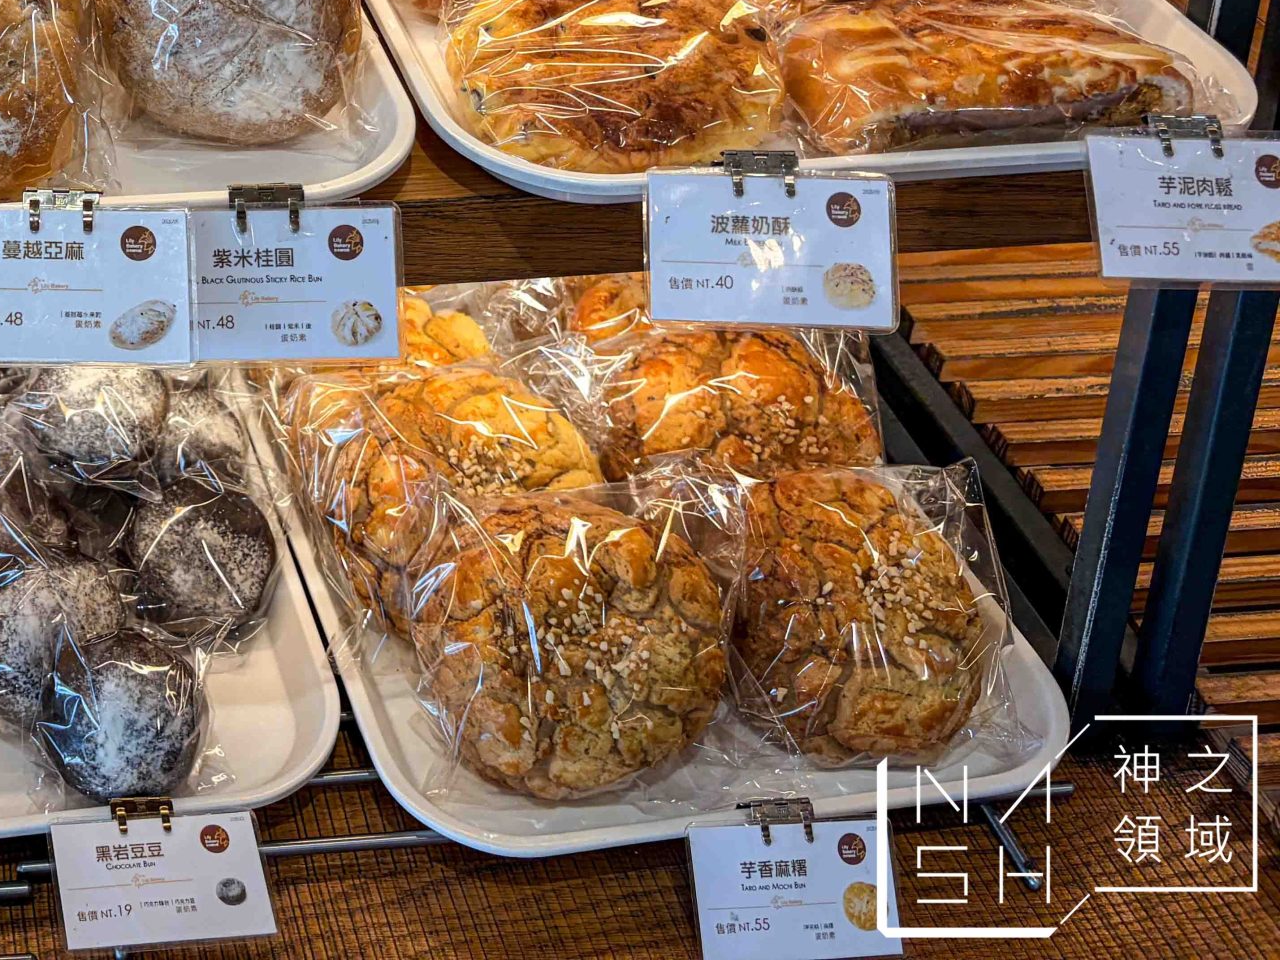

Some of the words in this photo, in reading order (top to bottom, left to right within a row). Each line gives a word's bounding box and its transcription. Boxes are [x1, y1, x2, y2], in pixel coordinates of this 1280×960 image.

[1158, 175, 1233, 197] 芋泥肉鬆
[710, 214, 790, 236] 波蘿奶酥
[2, 240, 84, 261] 蔓越亞麻
[212, 247, 294, 269] 紫米桂圓
[1118, 244, 1141, 257] 售價
[1144, 242, 1179, 256] NT.55
[201, 276, 224, 284] BLACK
[669, 276, 693, 290] 售價
[696, 275, 734, 289] NT.40
[197, 315, 235, 330] NT.48
[95, 841, 164, 862] 黑岩豆豆
[739, 859, 807, 879] 芋香麻糬
[77, 910, 98, 922] 售價
[100, 903, 133, 919] NT.19
[715, 923, 736, 935] 售價
[738, 917, 770, 933] NT.55
